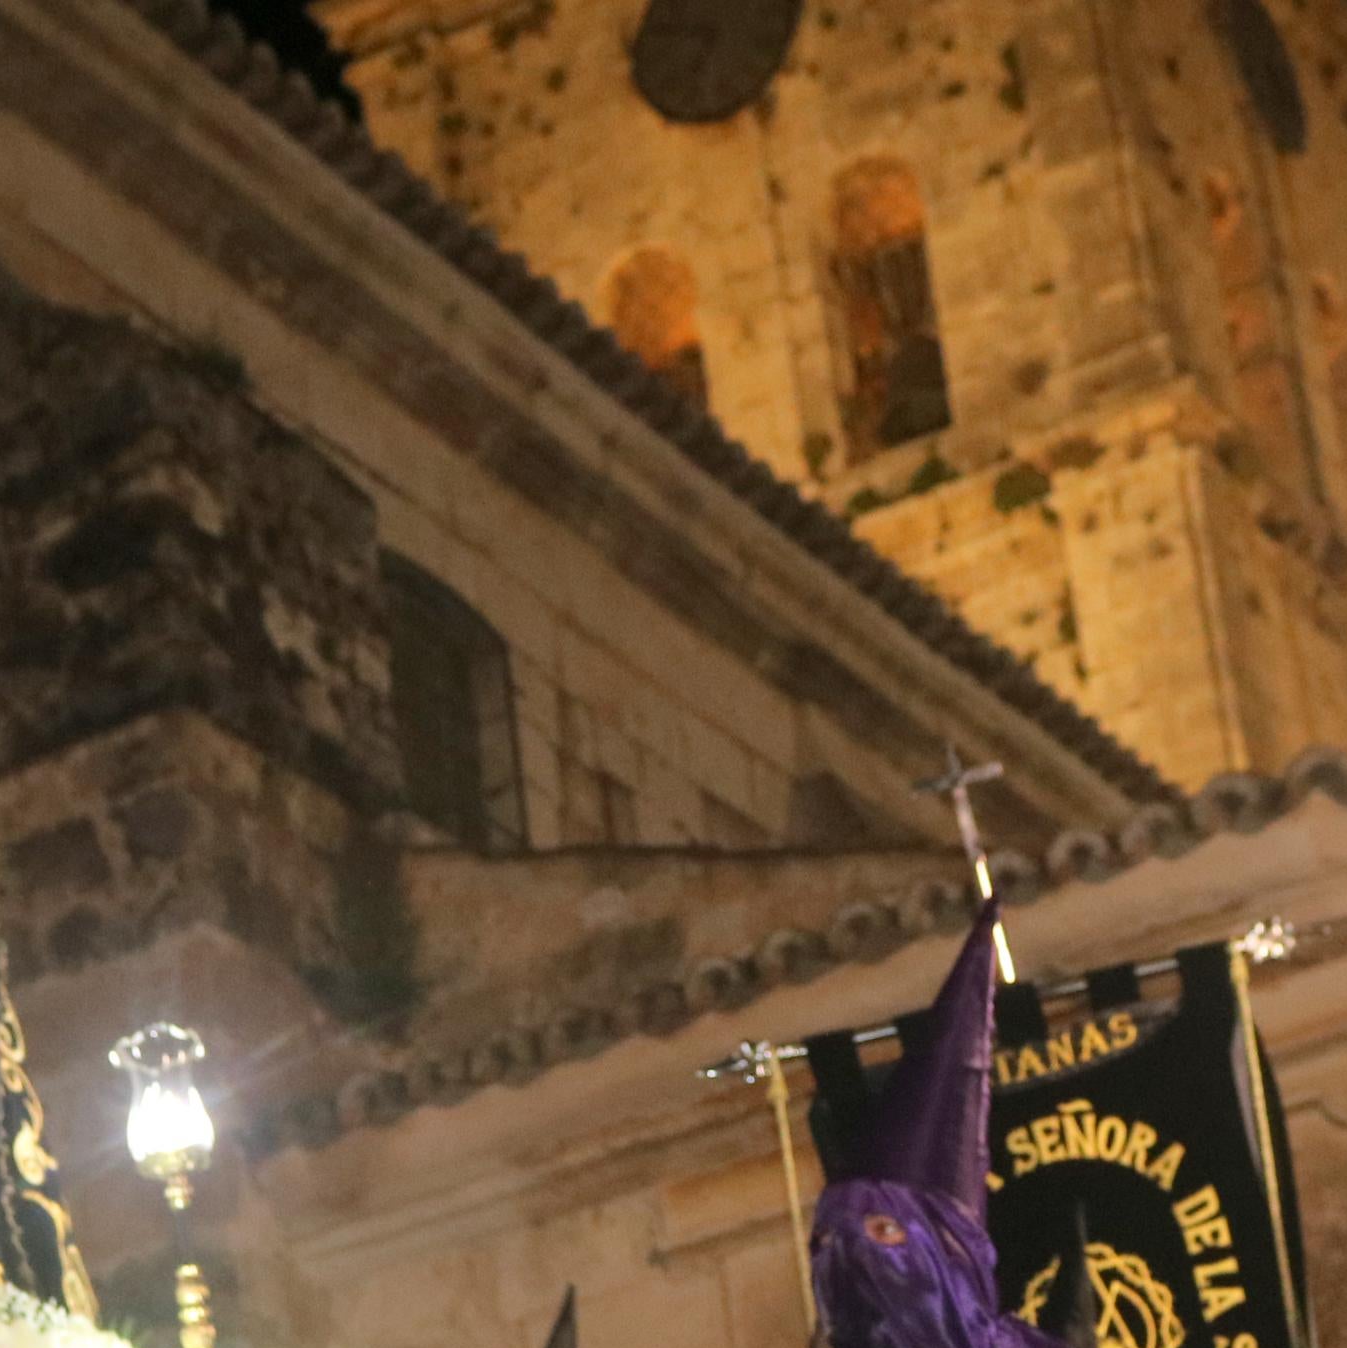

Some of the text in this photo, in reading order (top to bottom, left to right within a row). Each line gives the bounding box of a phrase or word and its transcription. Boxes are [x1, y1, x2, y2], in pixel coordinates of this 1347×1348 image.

[1006, 1099, 1186, 1191] SEÑORA
[1172, 1184, 1232, 1255] DE
[1193, 1256, 1246, 1323] LA
